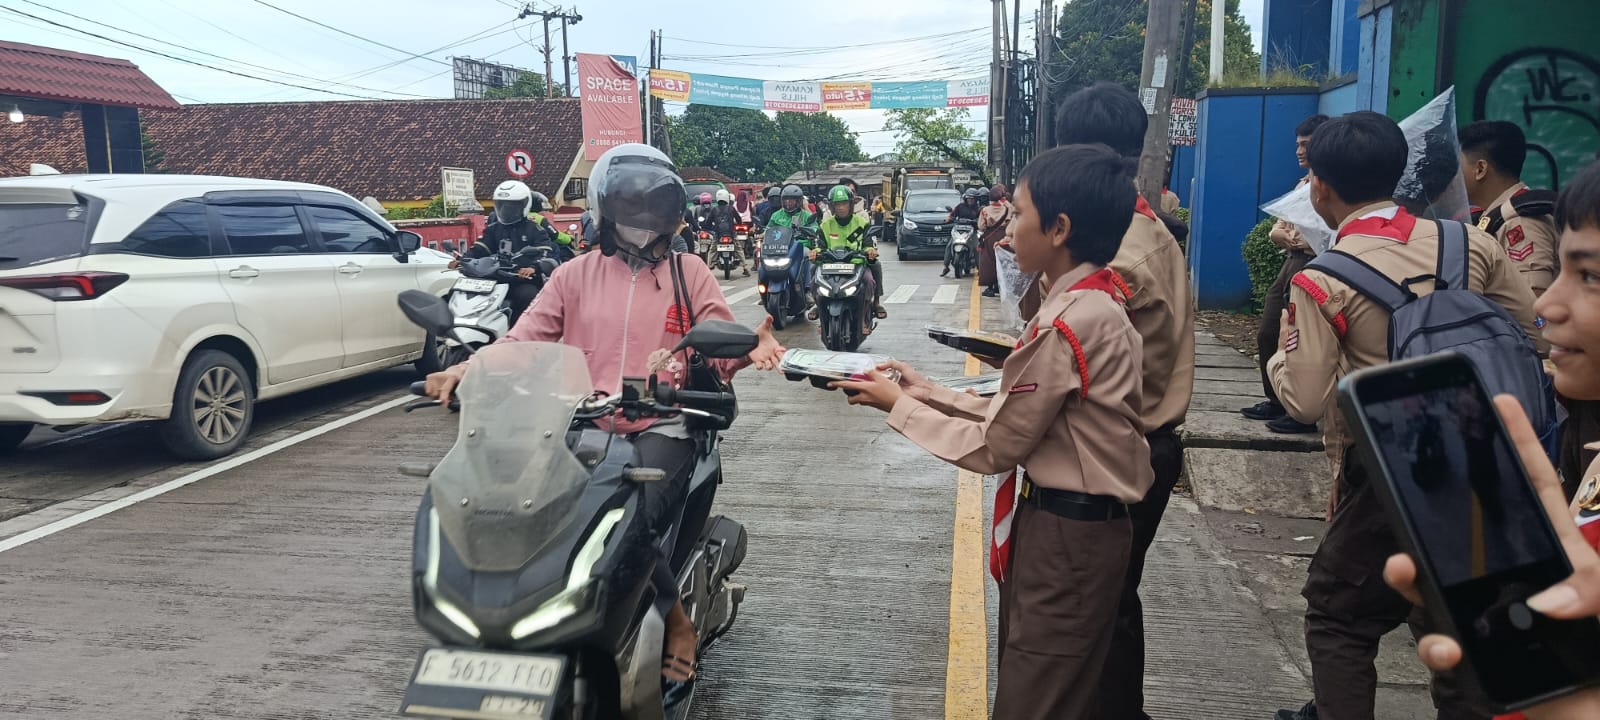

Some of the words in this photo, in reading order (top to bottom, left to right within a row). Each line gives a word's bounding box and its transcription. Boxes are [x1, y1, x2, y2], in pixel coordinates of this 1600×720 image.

[587, 77, 632, 91] SPACE
[587, 94, 633, 104] AVAILABLE
[422, 654, 441, 677] F
[448, 656, 503, 683] 5612
